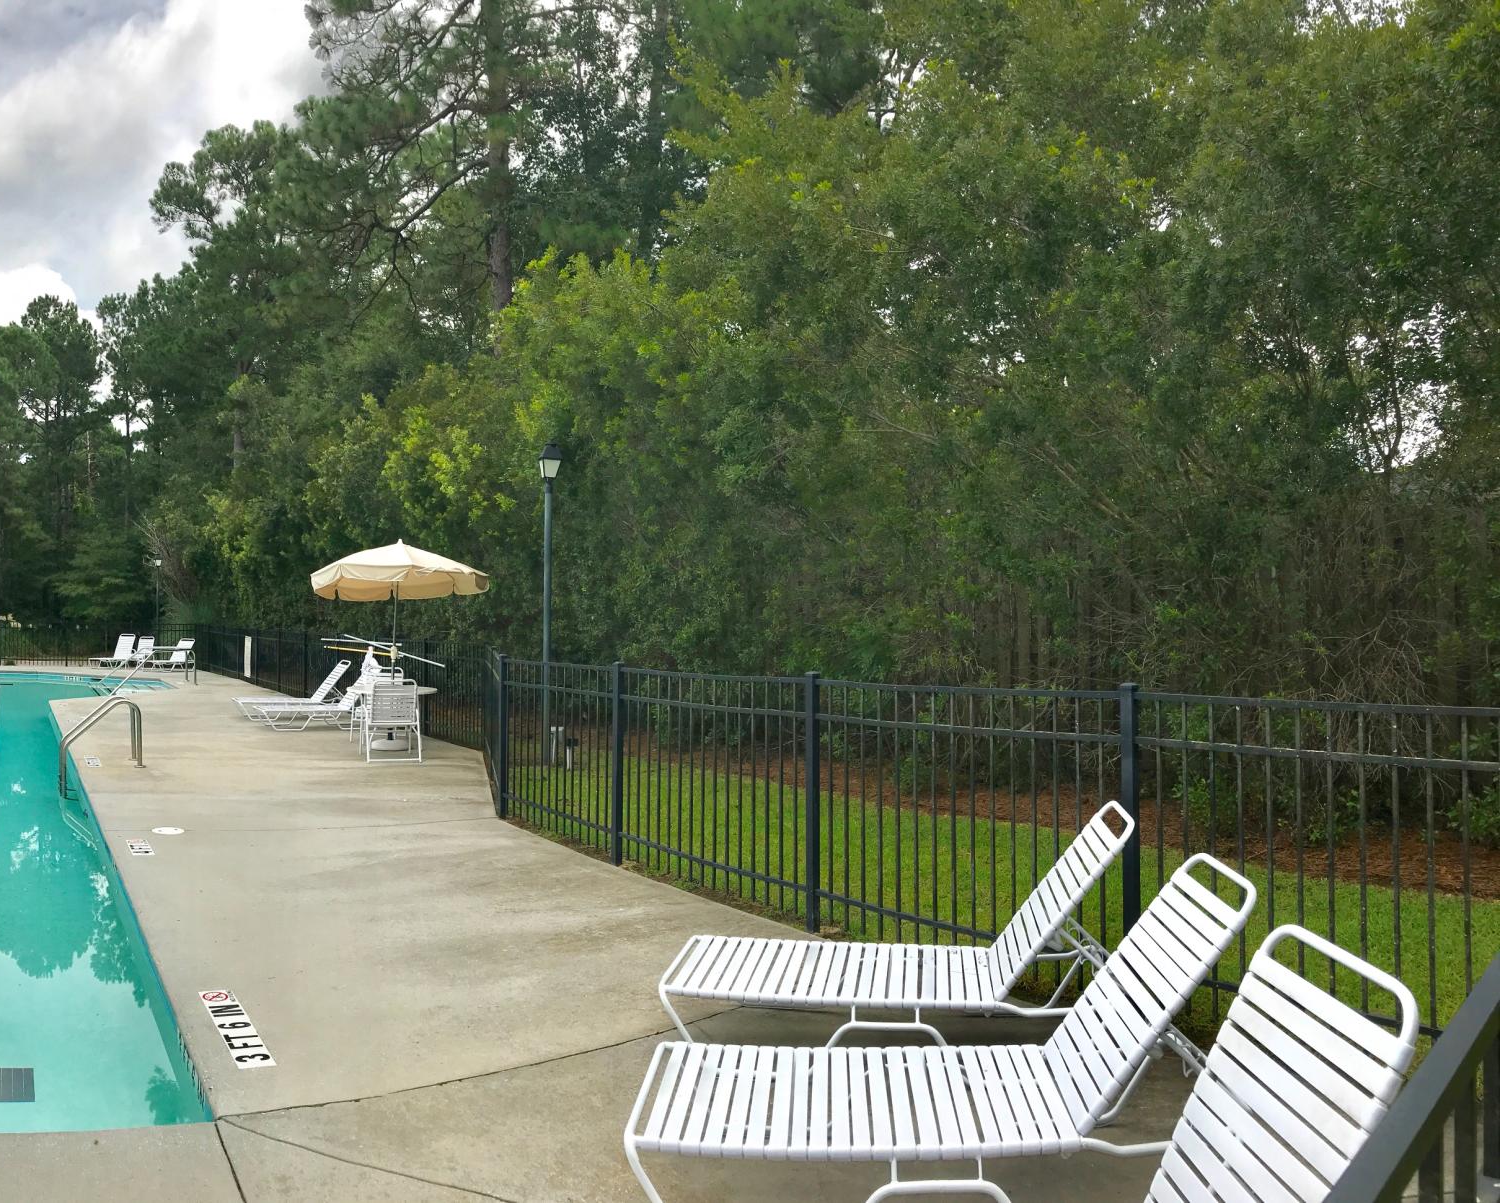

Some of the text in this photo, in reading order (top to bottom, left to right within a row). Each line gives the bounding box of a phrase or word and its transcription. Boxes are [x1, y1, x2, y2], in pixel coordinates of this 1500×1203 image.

[208, 1004, 271, 1063] 3 FT 6 IN
